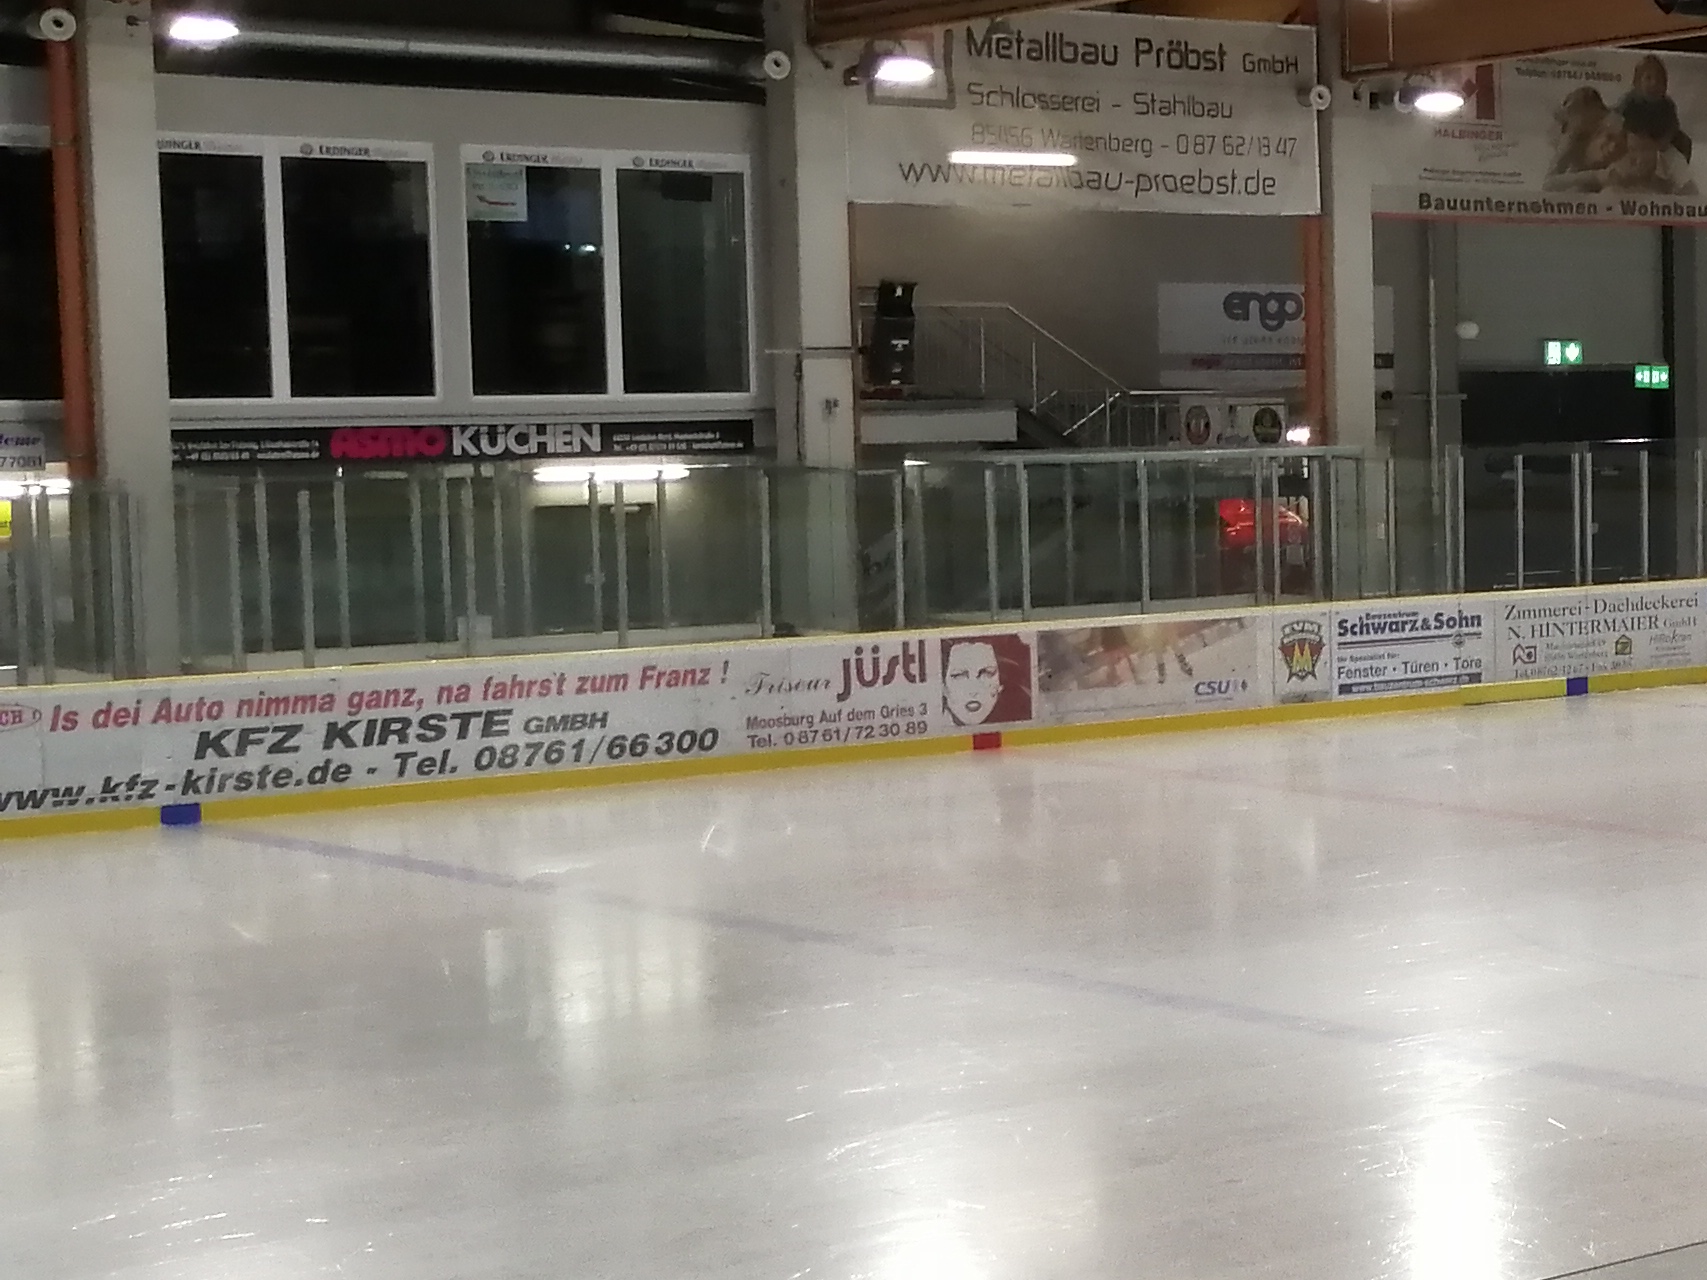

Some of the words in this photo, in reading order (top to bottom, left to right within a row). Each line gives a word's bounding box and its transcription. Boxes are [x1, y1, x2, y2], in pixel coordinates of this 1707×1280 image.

[966, 26, 1119, 67] Metallbau
[1134, 38, 1228, 73] Pröbst
[1242, 53, 1299, 74] GmbH
[966, 82, 1101, 113] Schlosserei
[1133, 91, 1234, 118] Stahlbau
[1040, 126, 1154, 158] Wartenberg
[1418, 193, 1598, 215] Bauunternehmen
[1222, 291, 1304, 332] engo
[451, 422, 602, 456] KÜCHEN
[1504, 600, 1582, 621] Zimmerei
[1593, 592, 1699, 615] Dachdeckerei
[1337, 609, 1482, 637] Schwarz&Sohn
[1507, 625, 1526, 641] N.
[1530, 614, 1660, 639] HINTERMAIER
[1337, 664, 1388, 680] Fenster
[1401, 660, 1439, 675] Türen
[1452, 656, 1482, 671] Tore
[49, 704, 80, 733] Is
[91, 698, 143, 729] dei
[151, 695, 225, 725] Auto
[235, 689, 336, 719] nimma
[347, 684, 426, 716] ganz,
[436, 682, 472, 704] na
[481, 669, 569, 701] fahrst
[574, 670, 630, 695] zum
[638, 664, 712, 690] Franz
[744, 670, 831, 698] Friseur
[1194, 679, 1235, 698] CSU
[745, 711, 815, 732] Moosburg
[818, 707, 844, 725] Auf
[846, 705, 876, 723] dem
[879, 702, 917, 722] Gries
[920, 702, 929, 717] 3
[194, 722, 303, 761] KFZ
[320, 707, 514, 752] KIRSTE
[522, 711, 609, 734] GMBH
[747, 732, 778, 749] Tel.
[393, 748, 460, 779] Tel.
